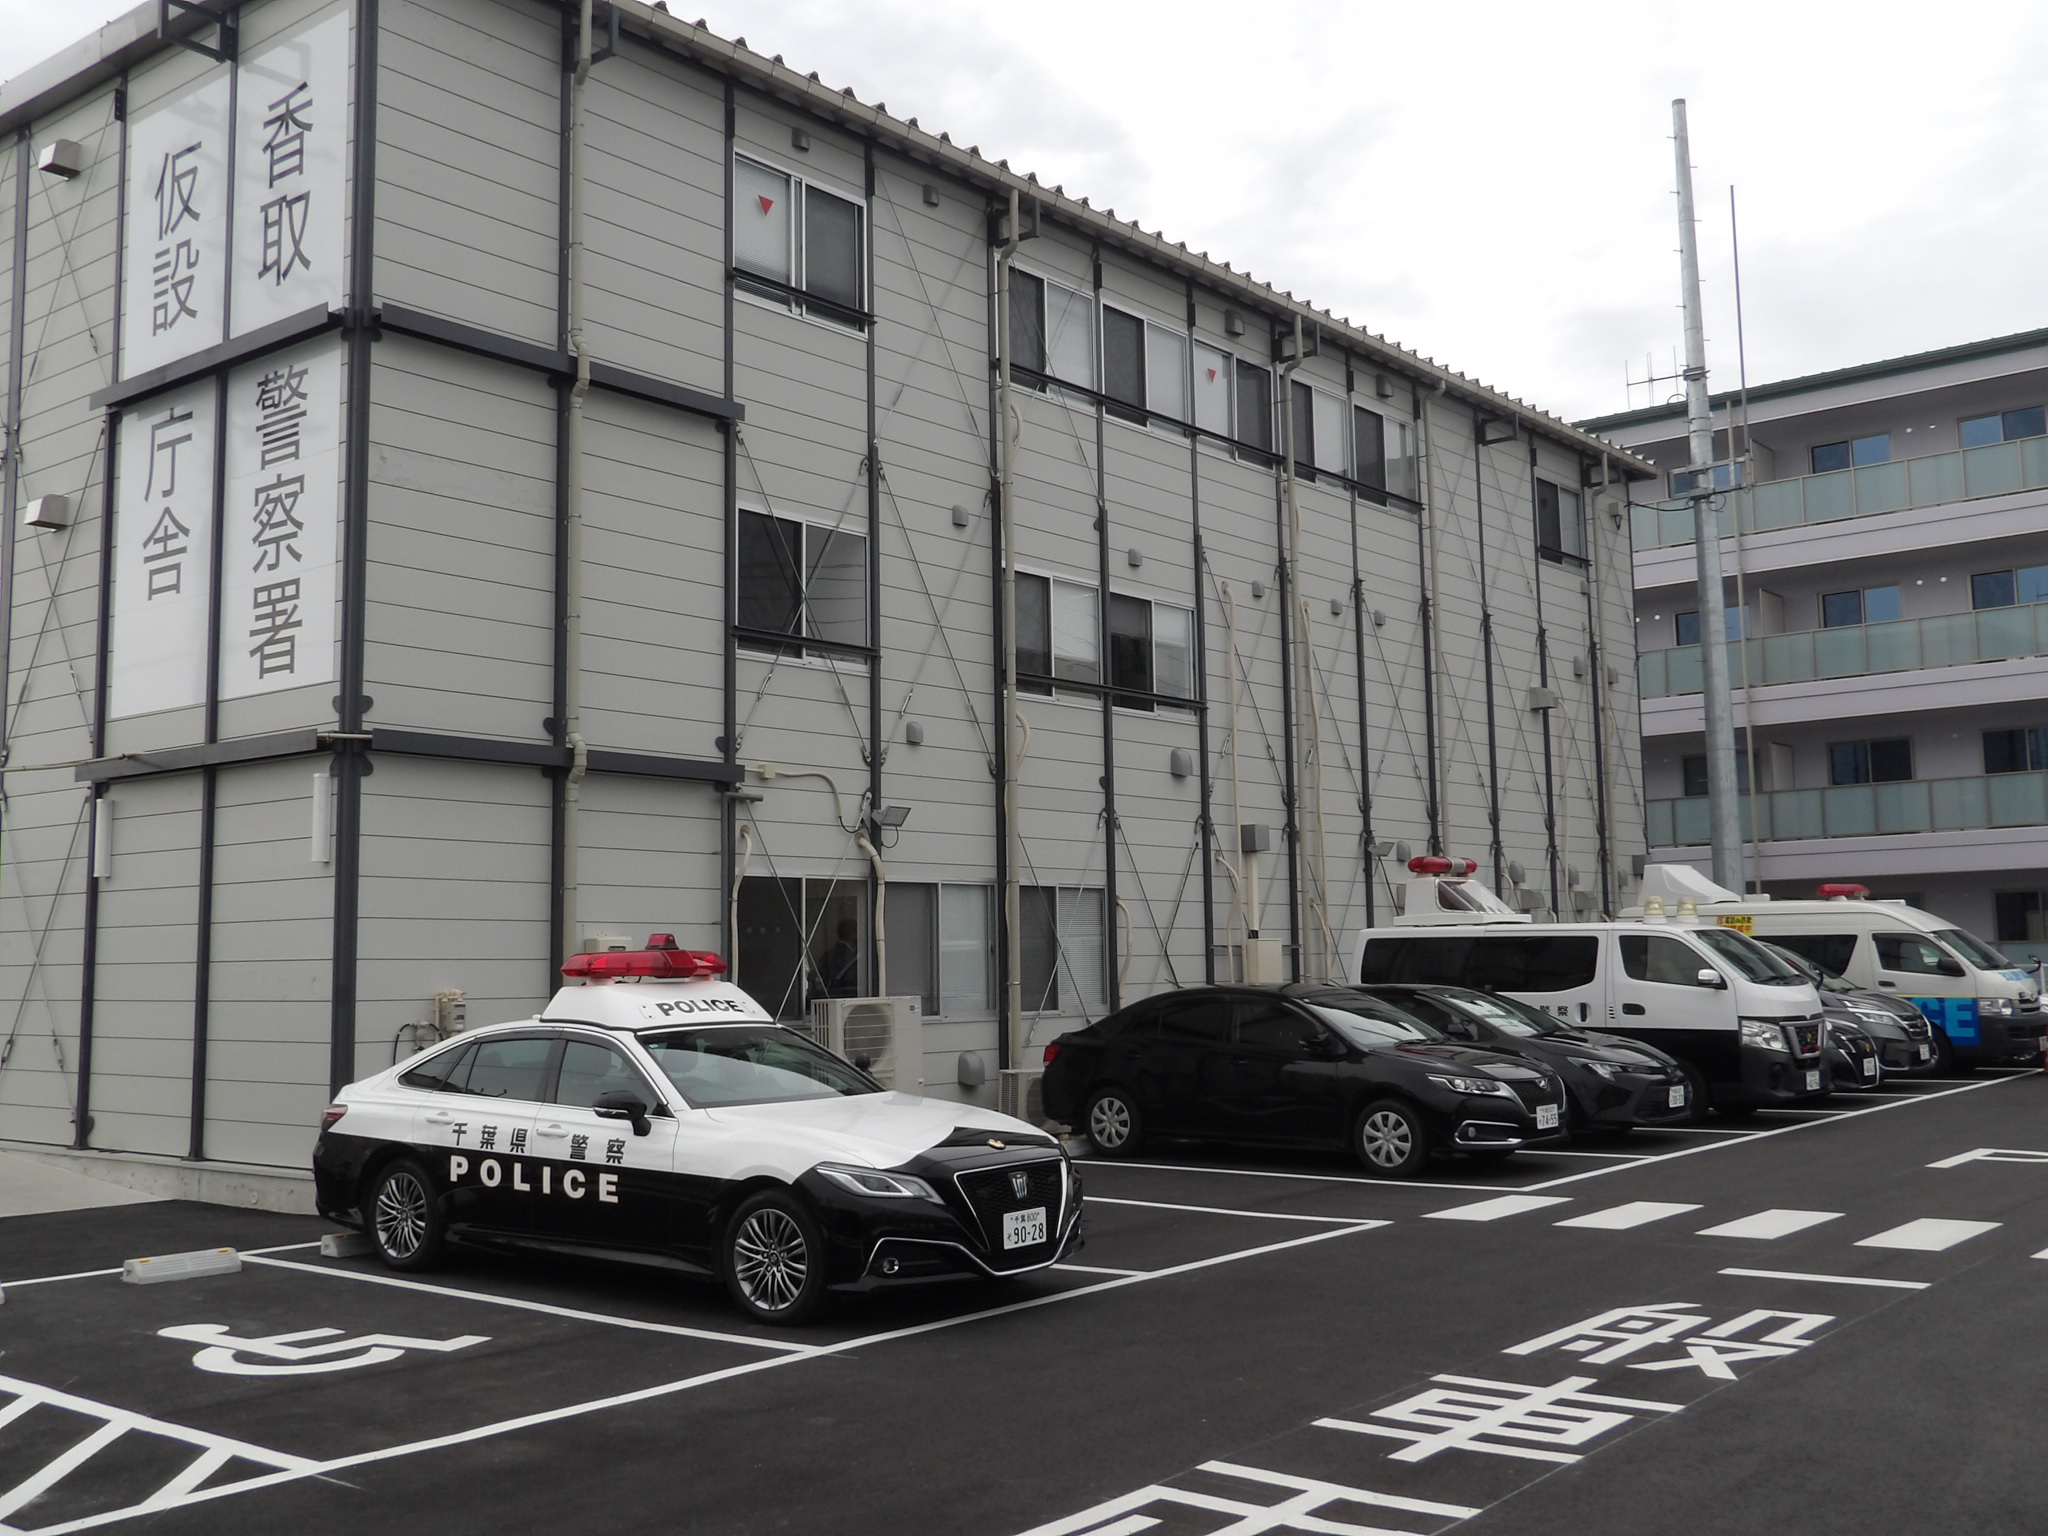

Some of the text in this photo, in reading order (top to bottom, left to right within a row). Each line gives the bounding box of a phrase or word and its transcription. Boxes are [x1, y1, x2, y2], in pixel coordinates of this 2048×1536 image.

[655, 999, 745, 1016] POLICE
[450, 1154, 619, 1204] POLICE
[1013, 1222, 1045, 1245] 90-28
